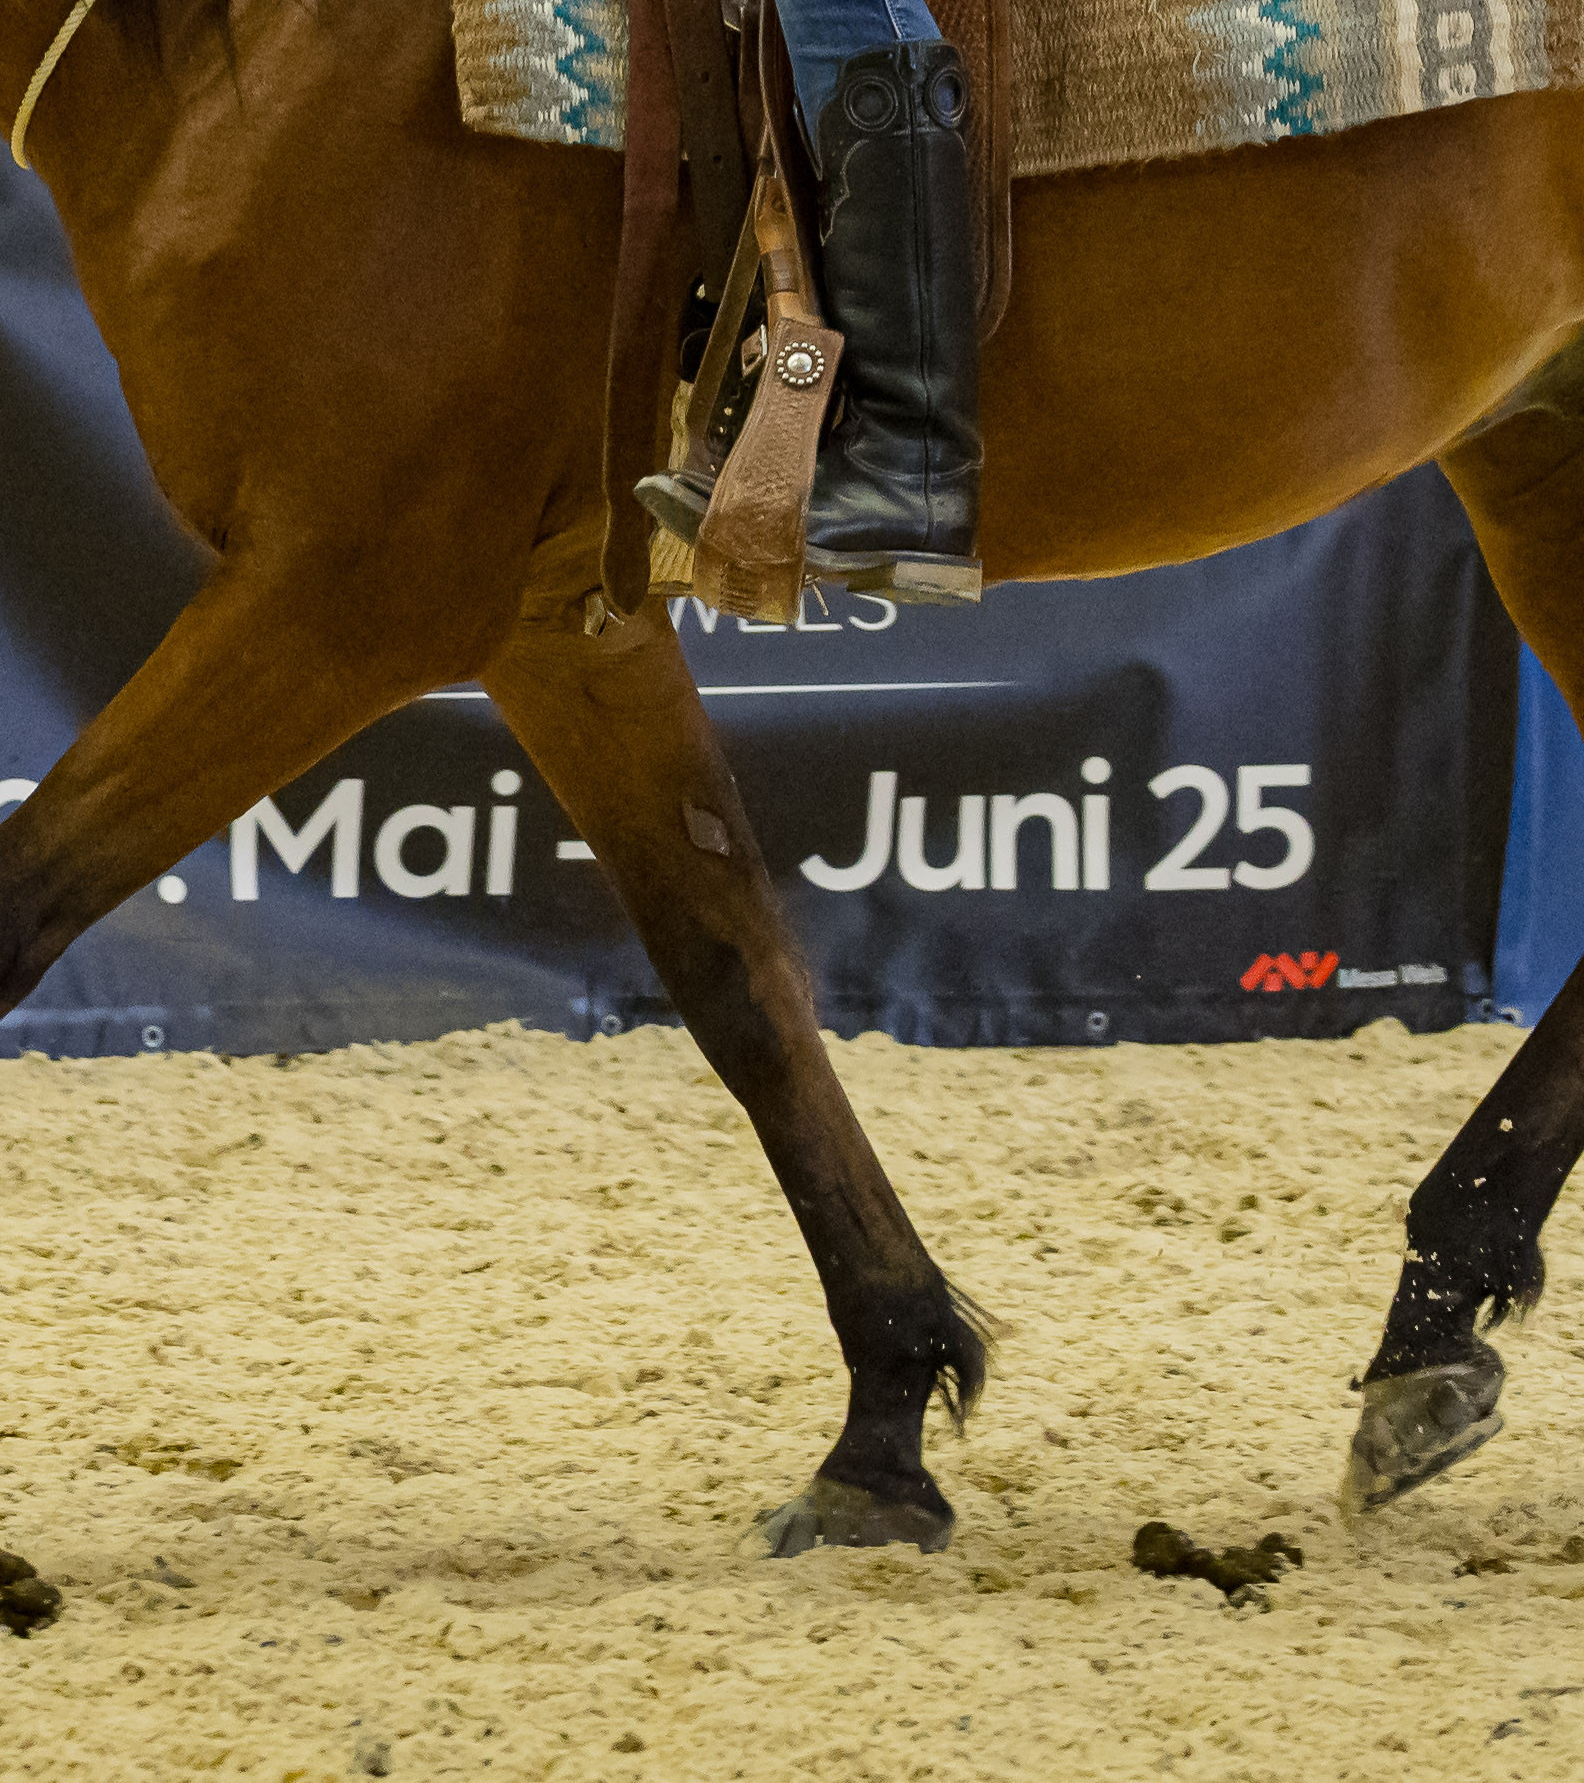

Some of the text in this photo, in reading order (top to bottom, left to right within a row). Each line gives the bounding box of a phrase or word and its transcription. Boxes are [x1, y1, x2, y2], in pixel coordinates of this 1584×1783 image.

[228, 768, 522, 903] Mai
[799, 756, 1113, 893] Juni
[1143, 763, 1315, 892] 25
